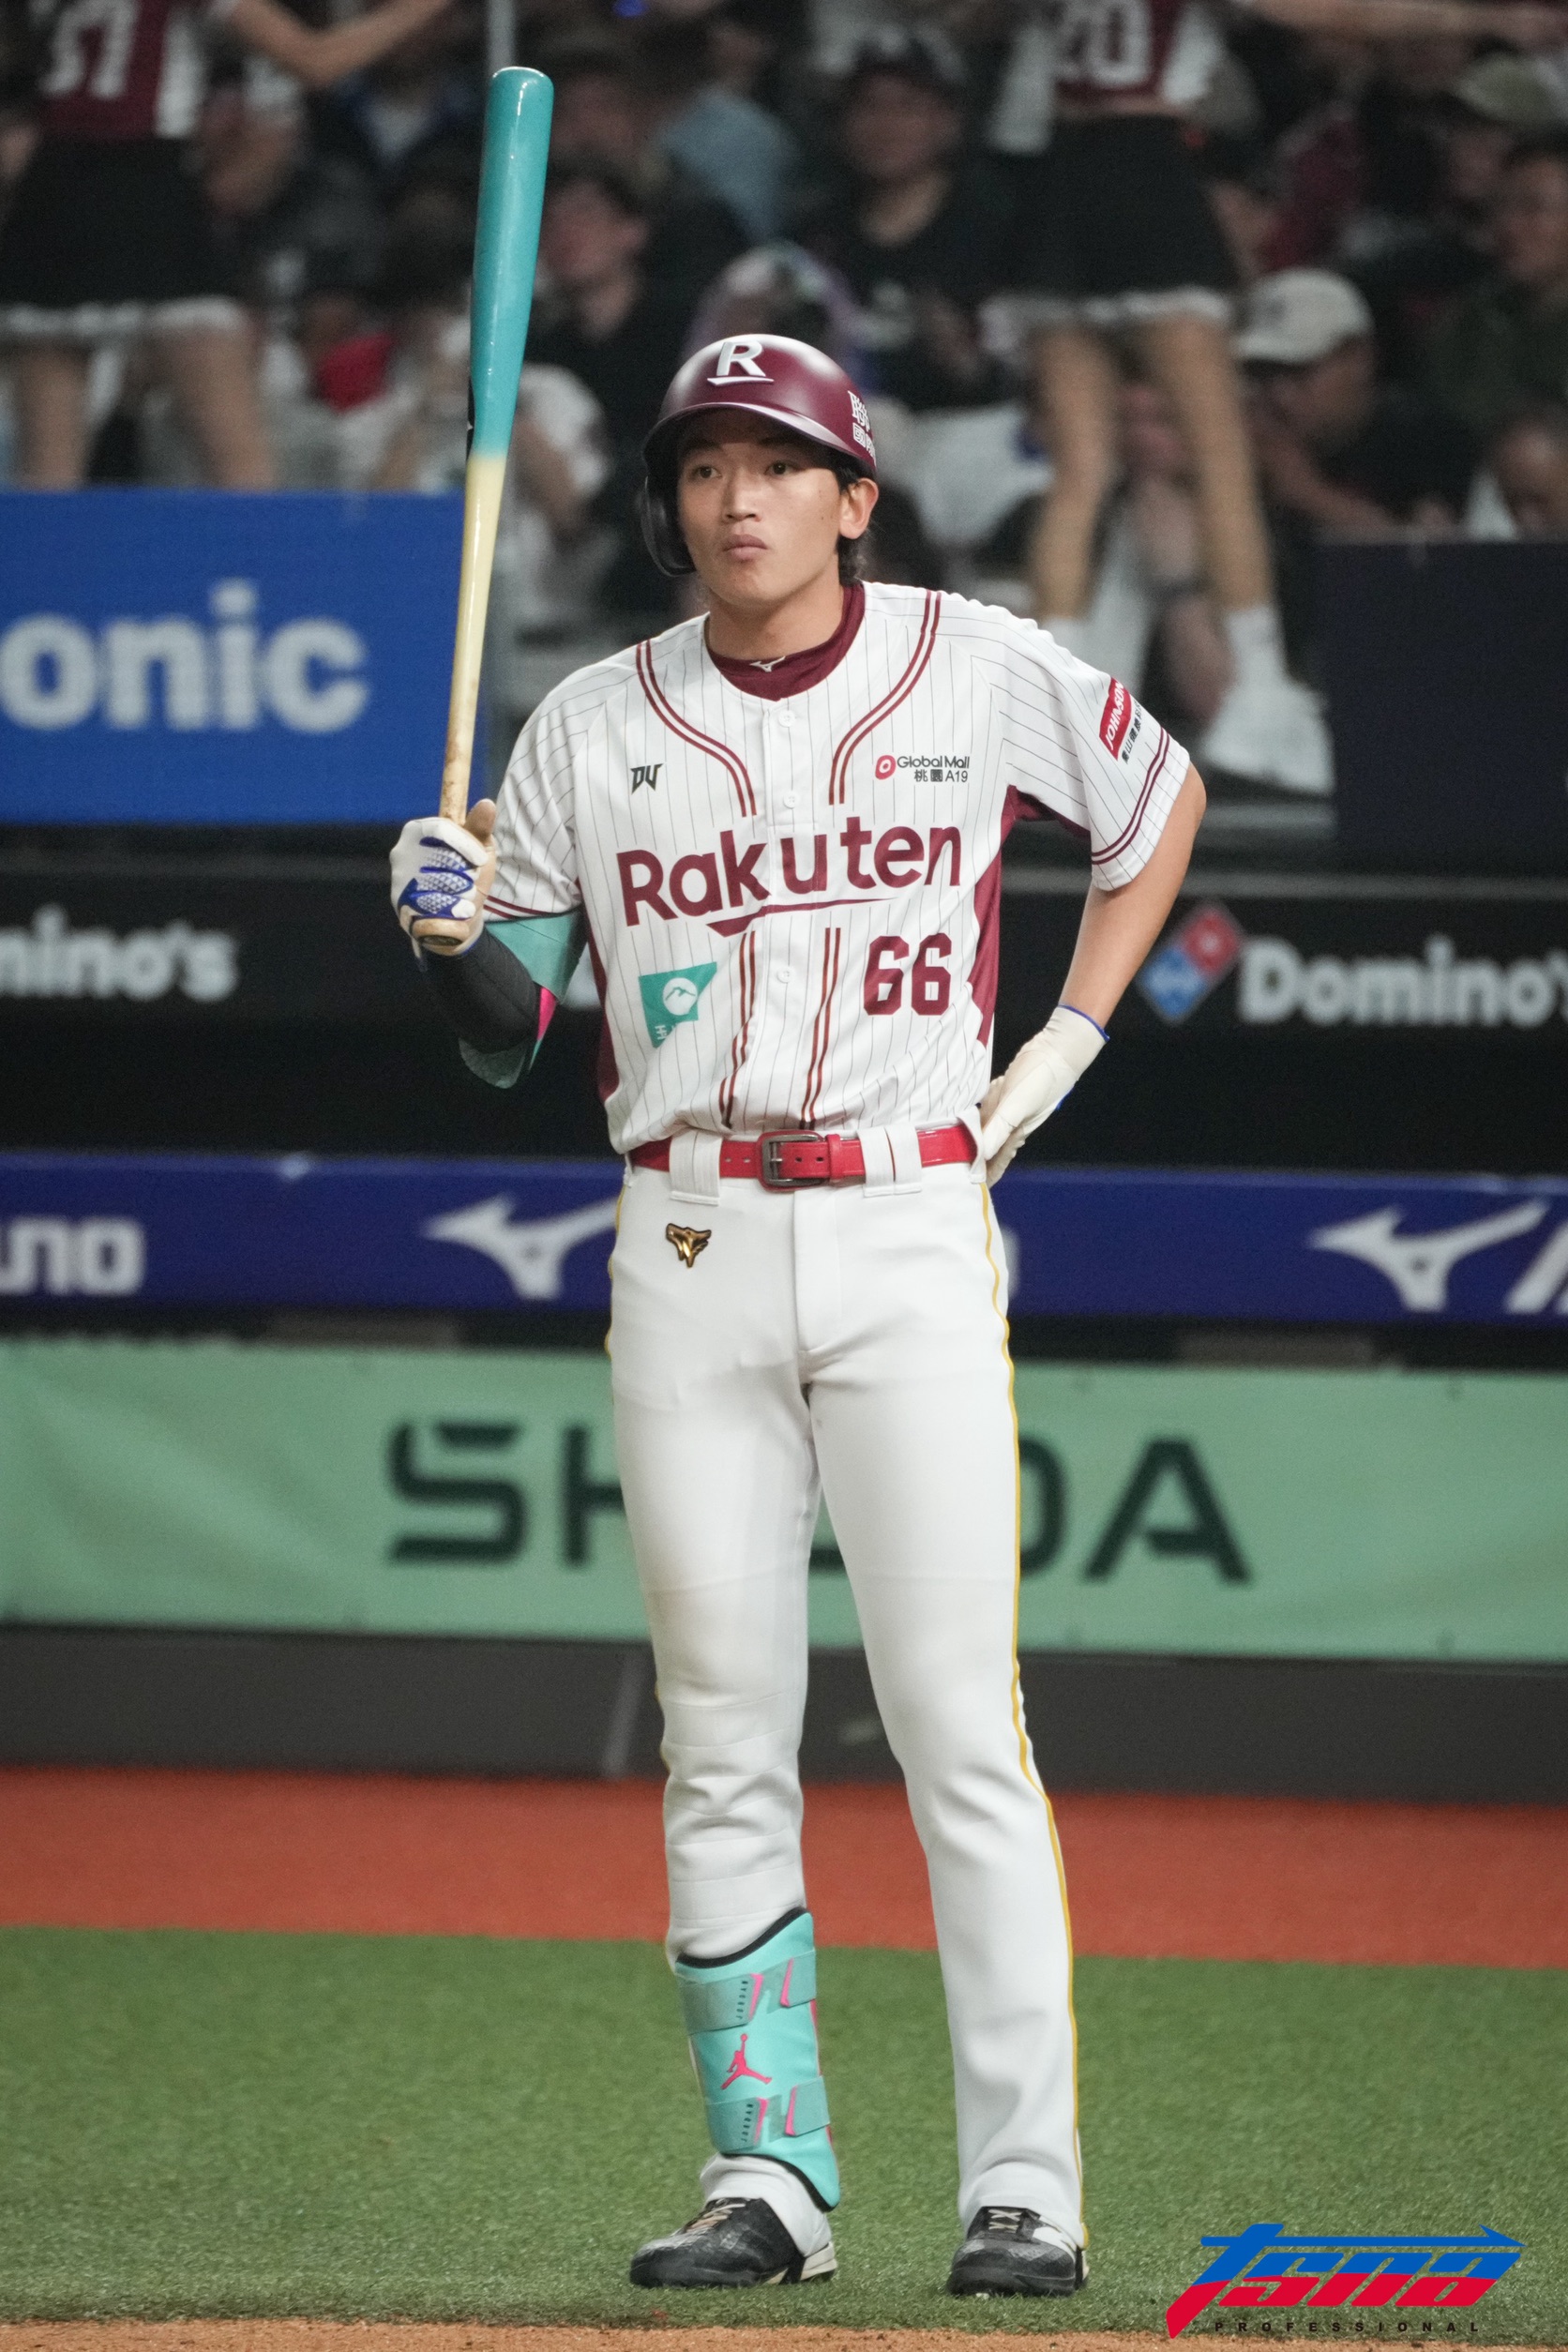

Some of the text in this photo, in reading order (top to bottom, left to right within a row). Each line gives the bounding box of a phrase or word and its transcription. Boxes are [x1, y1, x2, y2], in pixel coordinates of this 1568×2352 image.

[716, 340, 767, 377] R
[897, 755, 970, 769] Global Mall
[944, 769, 969, 783] A19
[615, 816, 962, 927] Rakuten
[863, 932, 952, 1016] 66
